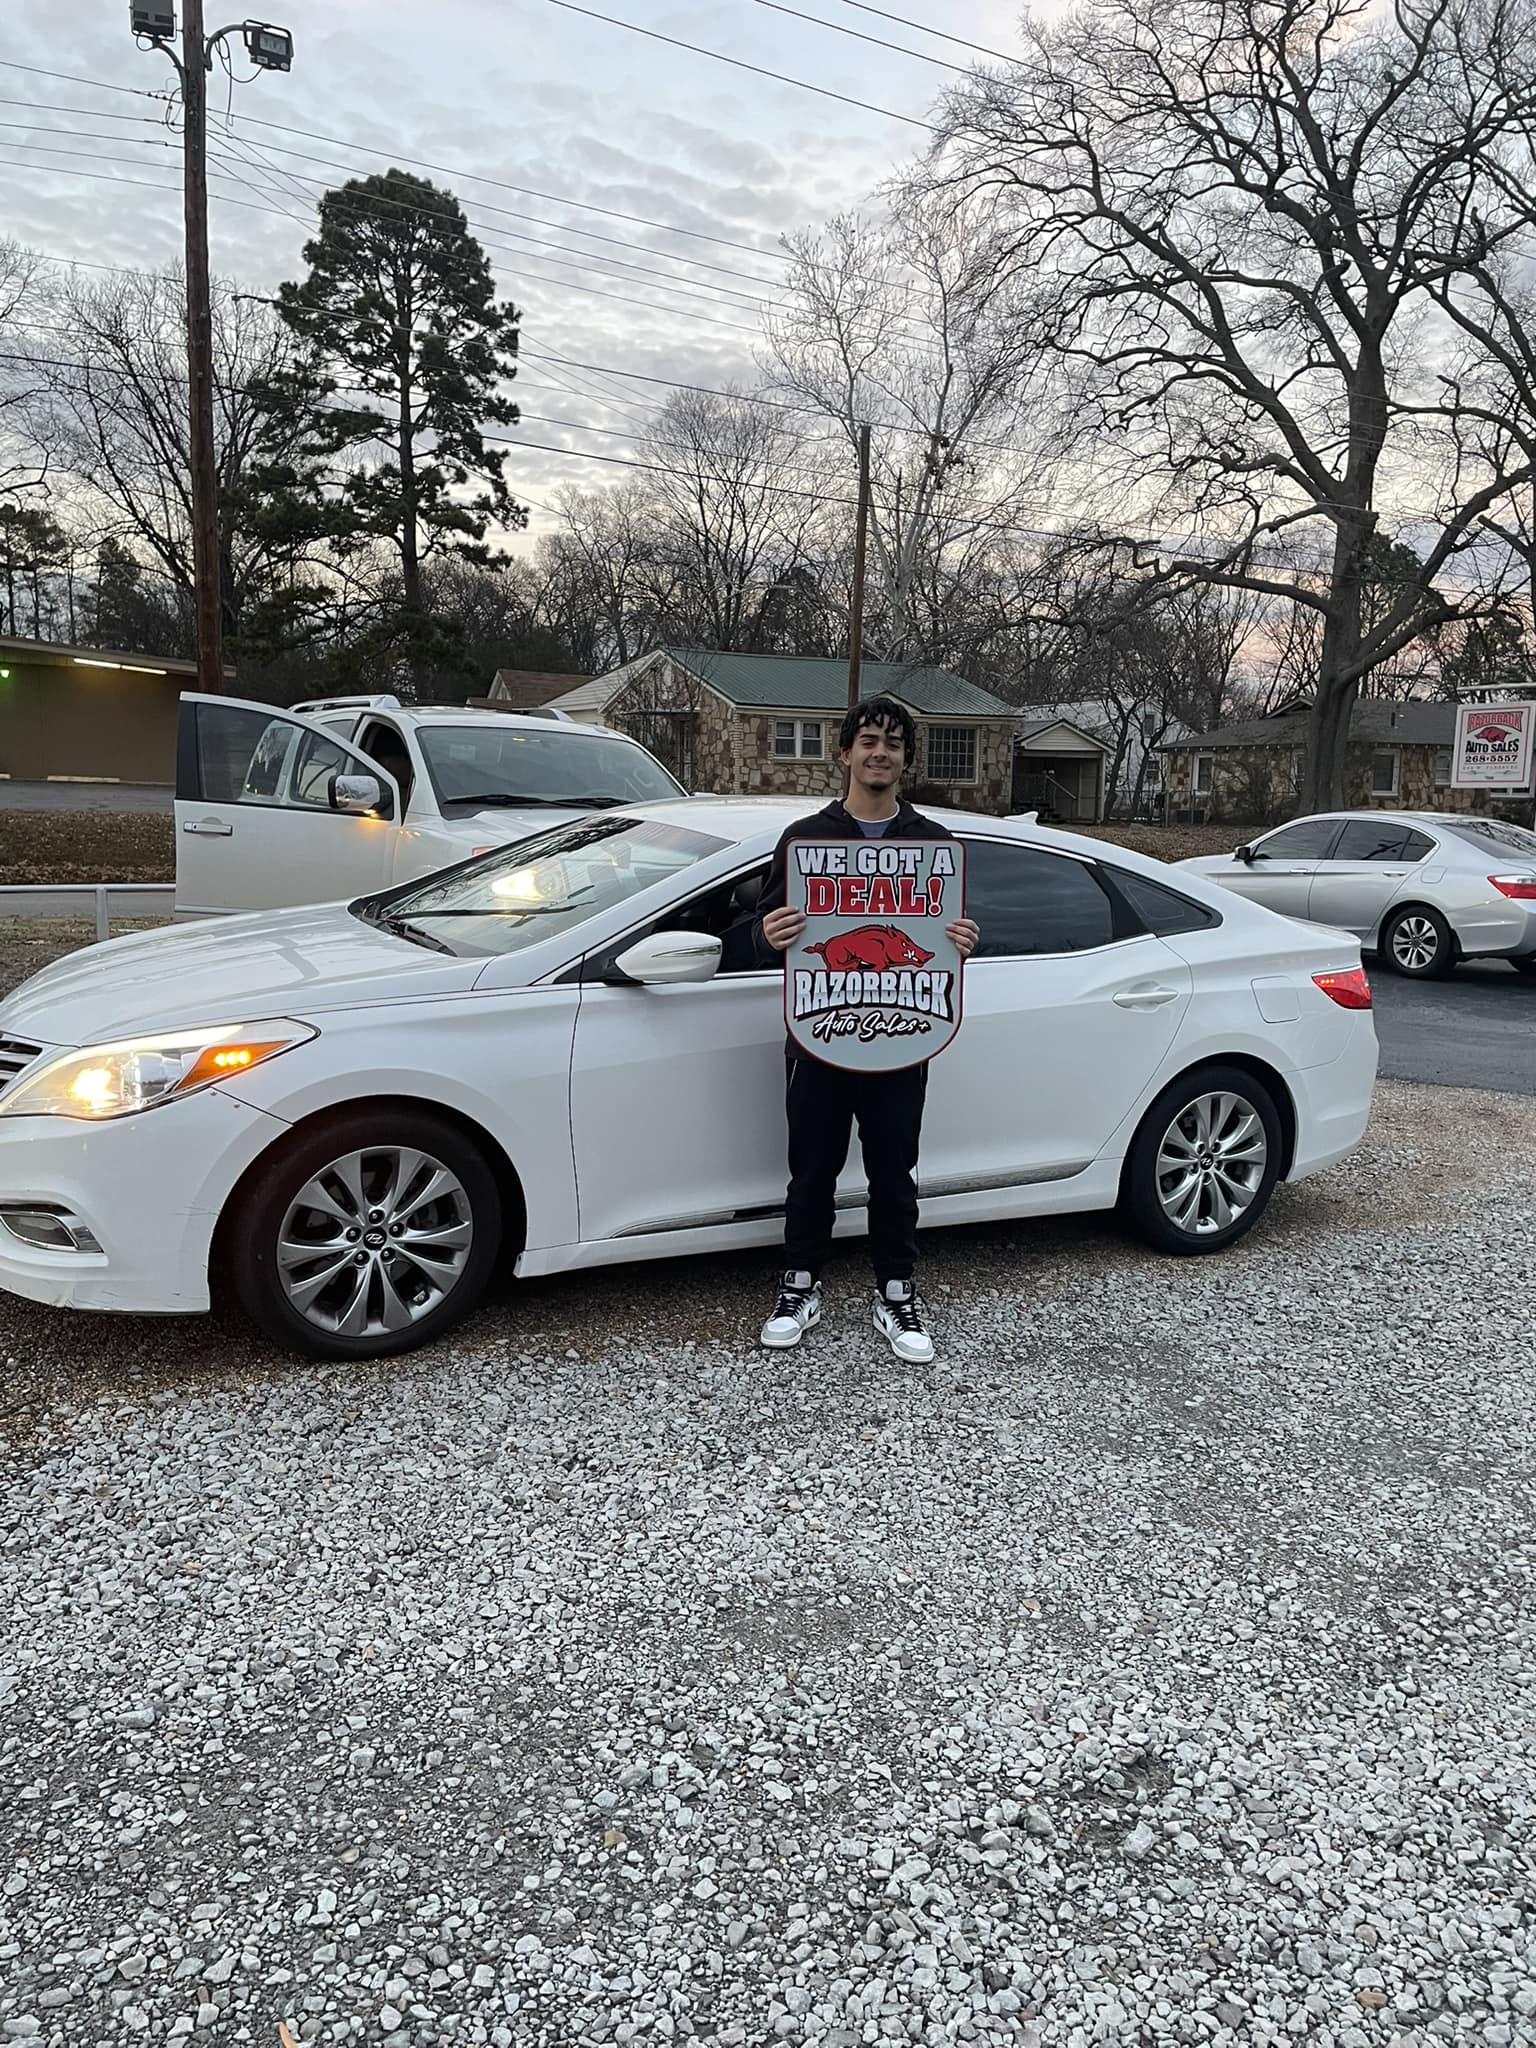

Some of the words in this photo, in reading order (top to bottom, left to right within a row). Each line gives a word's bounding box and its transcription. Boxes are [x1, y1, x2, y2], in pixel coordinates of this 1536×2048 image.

[1465, 740, 1489, 753] AUTO
[1490, 739, 1519, 753] SALES
[796, 847, 847, 874] WE
[857, 847, 923, 874] GOT
[932, 847, 955, 875] A
[805, 876, 944, 916] DEAL!
[794, 970, 953, 1022] RAZORBACK
[813, 1011, 859, 1042] Auto
